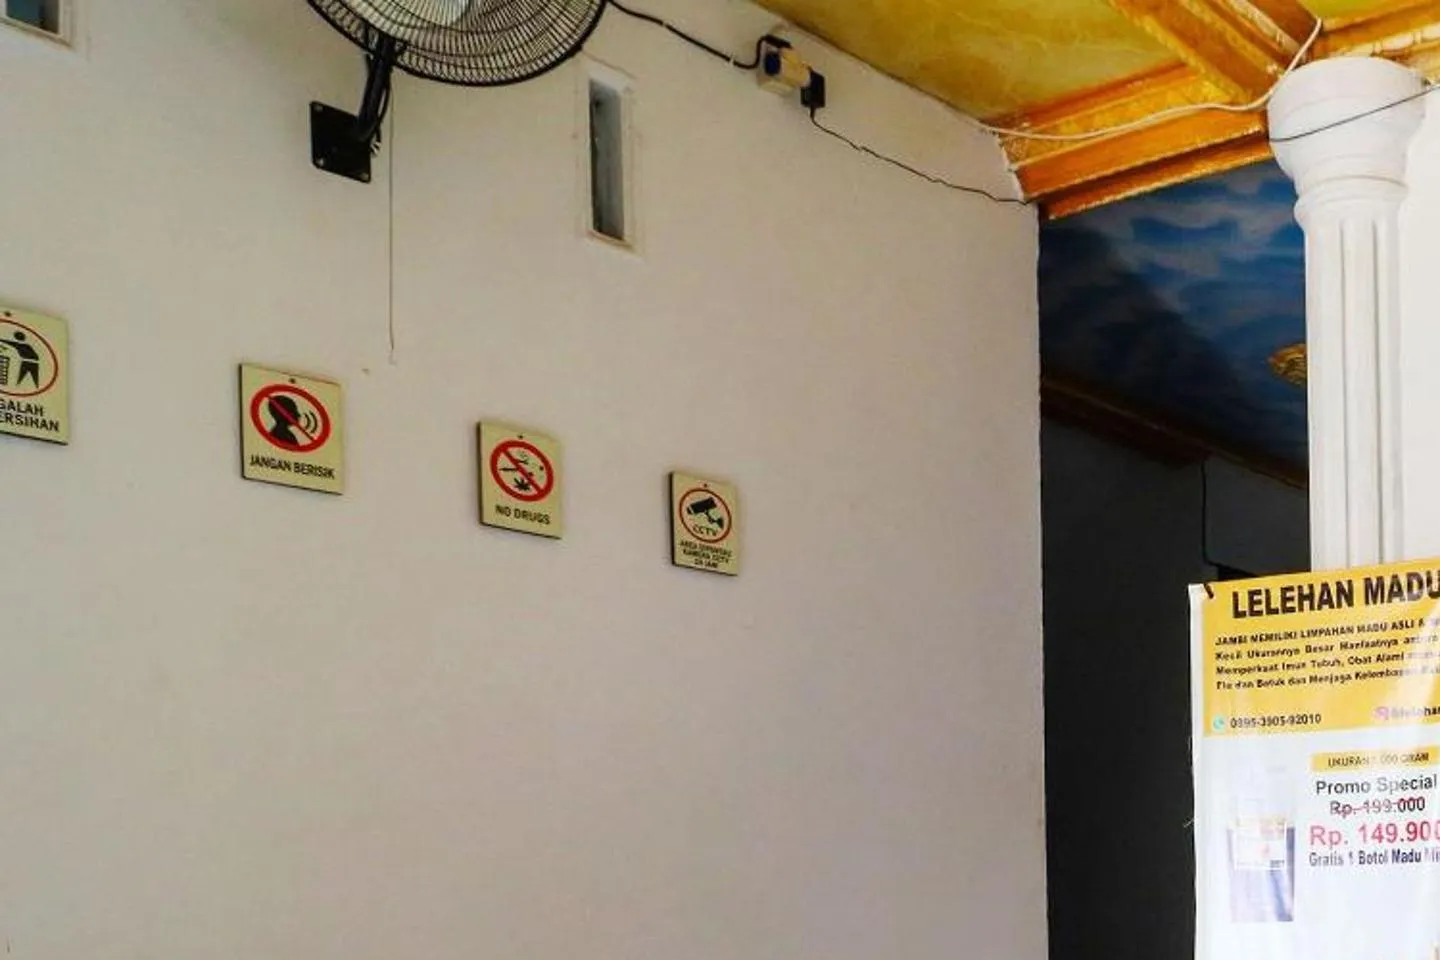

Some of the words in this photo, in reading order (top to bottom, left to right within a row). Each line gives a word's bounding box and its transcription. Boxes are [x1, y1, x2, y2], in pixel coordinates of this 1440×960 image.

[250, 453, 292, 471] JANGAN
[294, 461, 335, 479] BERISIK
[495, 504, 511, 517] NO
[514, 508, 551, 525] DRUGS
[1231, 579, 1354, 619] LELEHAN
[1215, 635, 1248, 646] JAMBI
[1250, 631, 1297, 643] MEMILIKI
[1300, 625, 1354, 638] LIMPAHAN
[1357, 622, 1388, 633] MADU
[1391, 619, 1415, 630] ASLI
[1247, 647, 1300, 659] Ukurannya
[1305, 644, 1334, 654] Besar
[1339, 639, 1399, 651] Manfaatnya
[1216, 663, 1279, 676] Memperkuat
[1347, 655, 1372, 665] Obat
[1375, 652, 1405, 662] Alami
[1234, 680, 1254, 689] dan
[1257, 678, 1285, 688] Batuk
[1288, 677, 1307, 686] dan
[1309, 674, 1352, 685] Menjaga
[1328, 754, 1370, 767] UKURAN
[1401, 752, 1430, 763] GRAM
[1316, 780, 1371, 795] Promo
[1376, 773, 1437, 795] Special
[1362, 796, 1426, 815] 199.000
[1310, 825, 1348, 849] Rp.
[1309, 851, 1344, 867] Gratis
[1358, 849, 1388, 865] Botol
[1391, 847, 1422, 863] Madu
